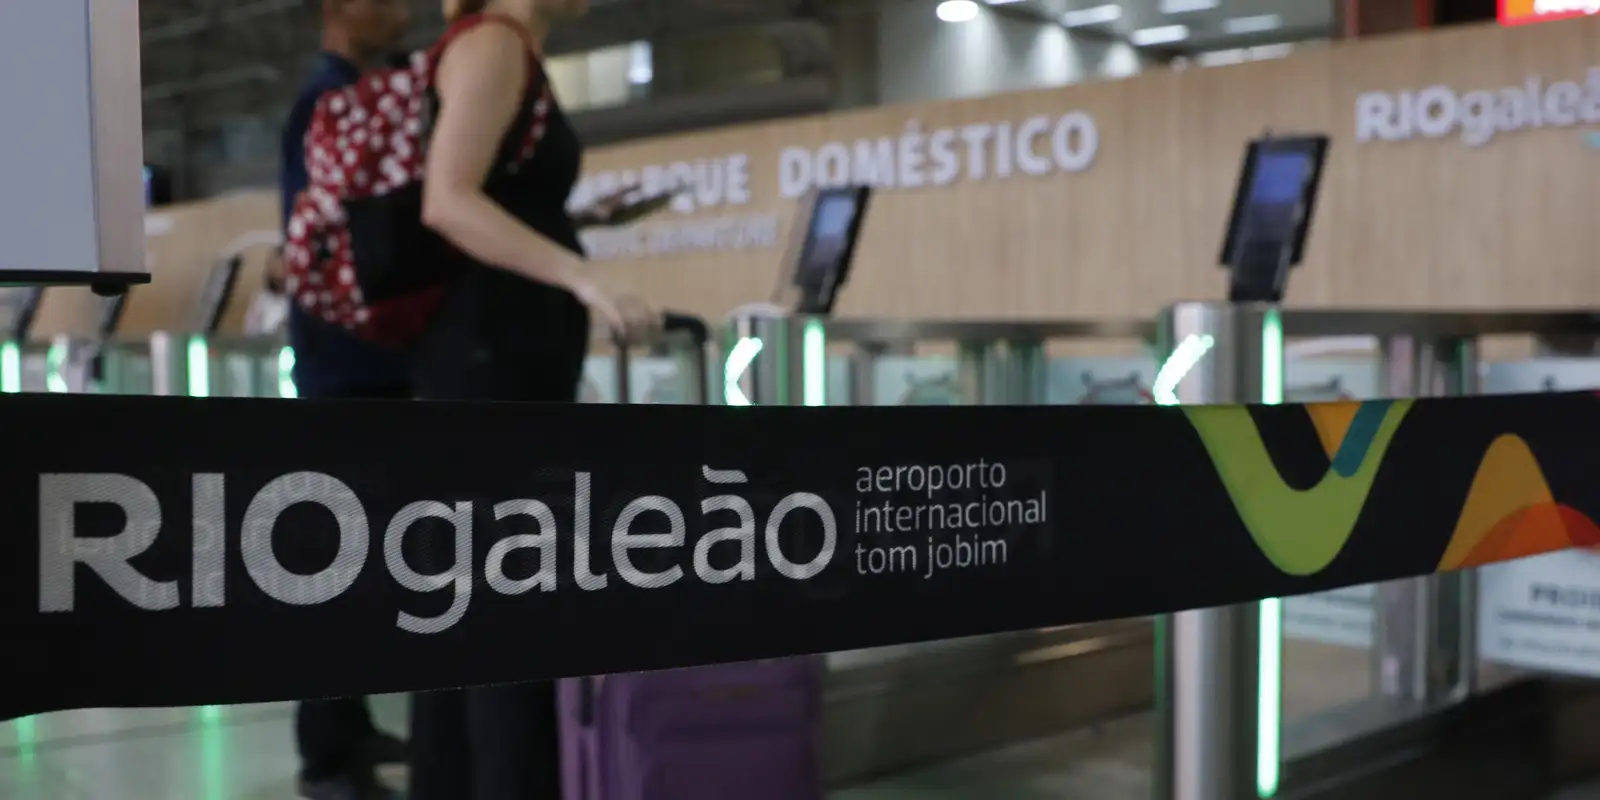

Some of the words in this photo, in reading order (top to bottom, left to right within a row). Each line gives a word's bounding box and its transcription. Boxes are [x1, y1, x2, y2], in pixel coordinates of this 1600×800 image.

[778, 110, 1099, 199] DOMÉSTICO
[856, 457, 1006, 499] aeroporto
[855, 489, 1047, 533] internacional
[38, 464, 838, 634] RIOgaleão
[855, 542, 917, 575] tom
[924, 533, 1007, 579] jobim
